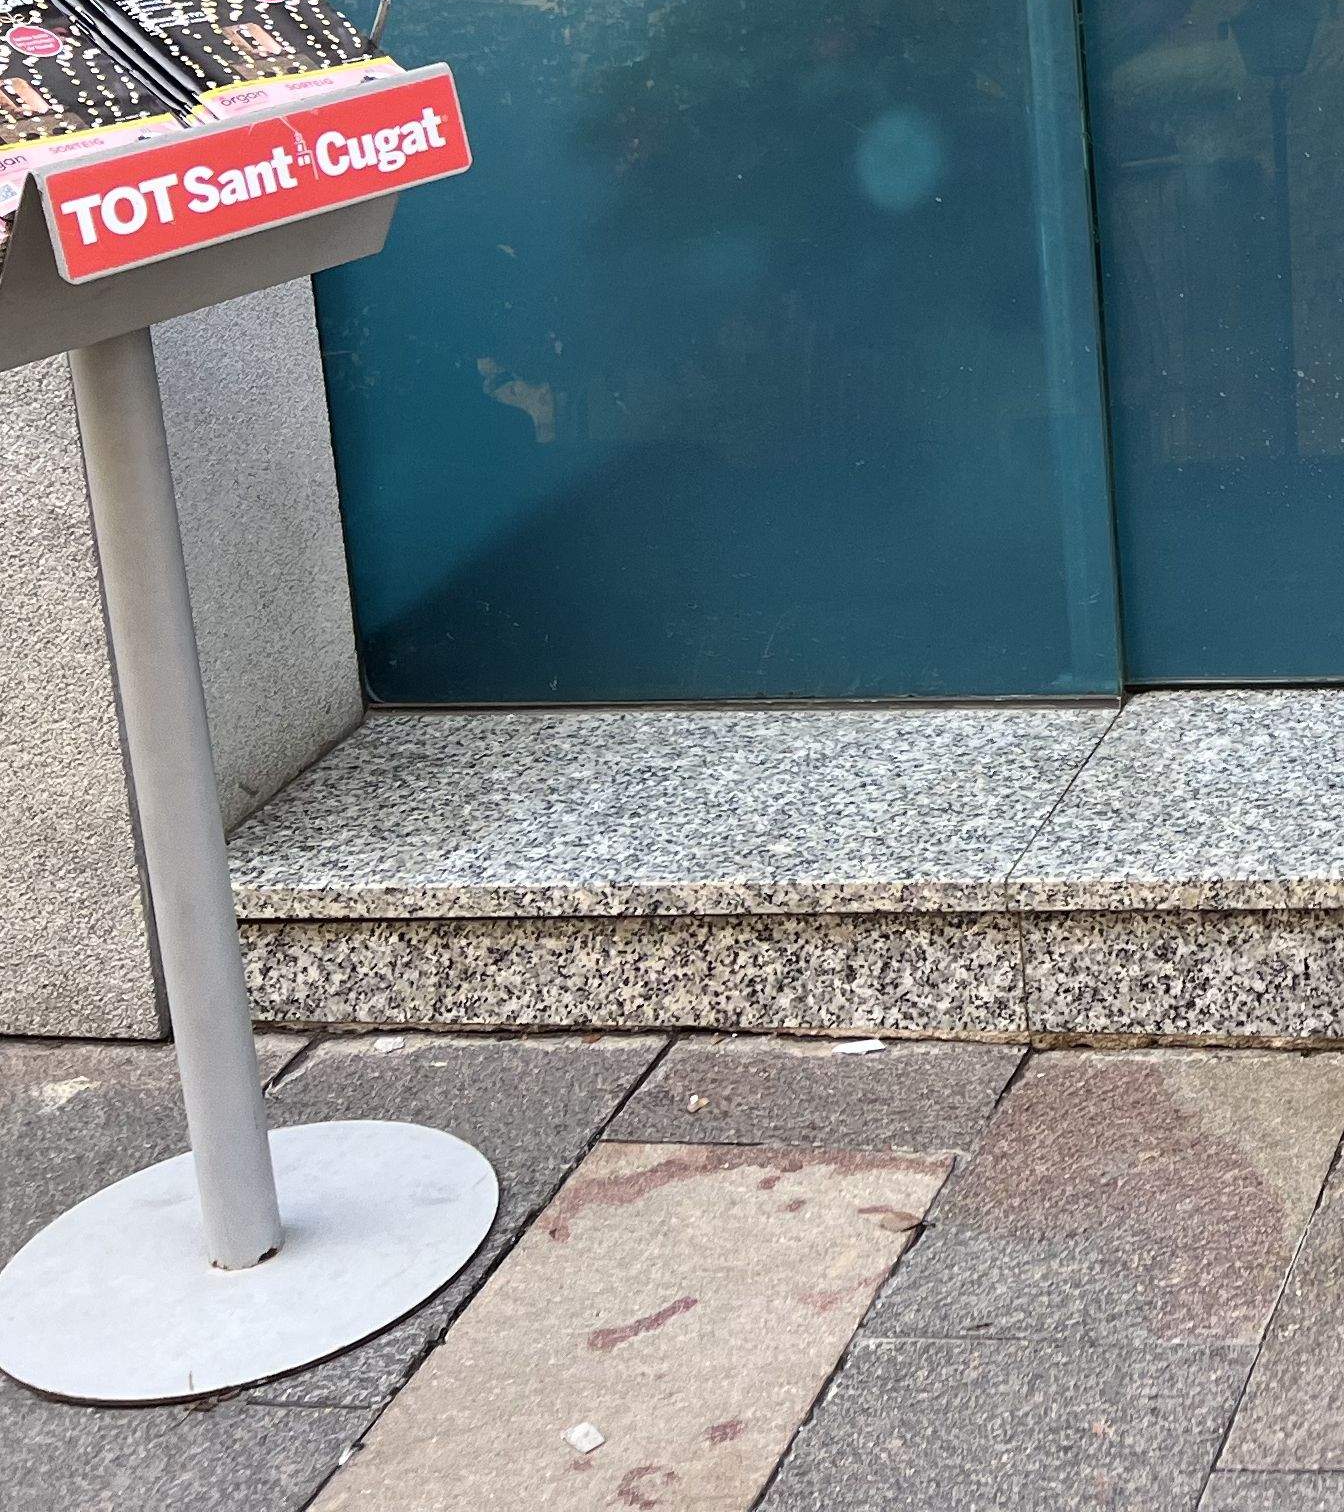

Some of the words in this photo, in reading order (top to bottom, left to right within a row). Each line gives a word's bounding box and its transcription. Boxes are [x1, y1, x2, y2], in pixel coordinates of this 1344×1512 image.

[60, 173, 178, 246] TOT
[183, 147, 298, 213] Sant
[314, 107, 447, 178] Cugat
